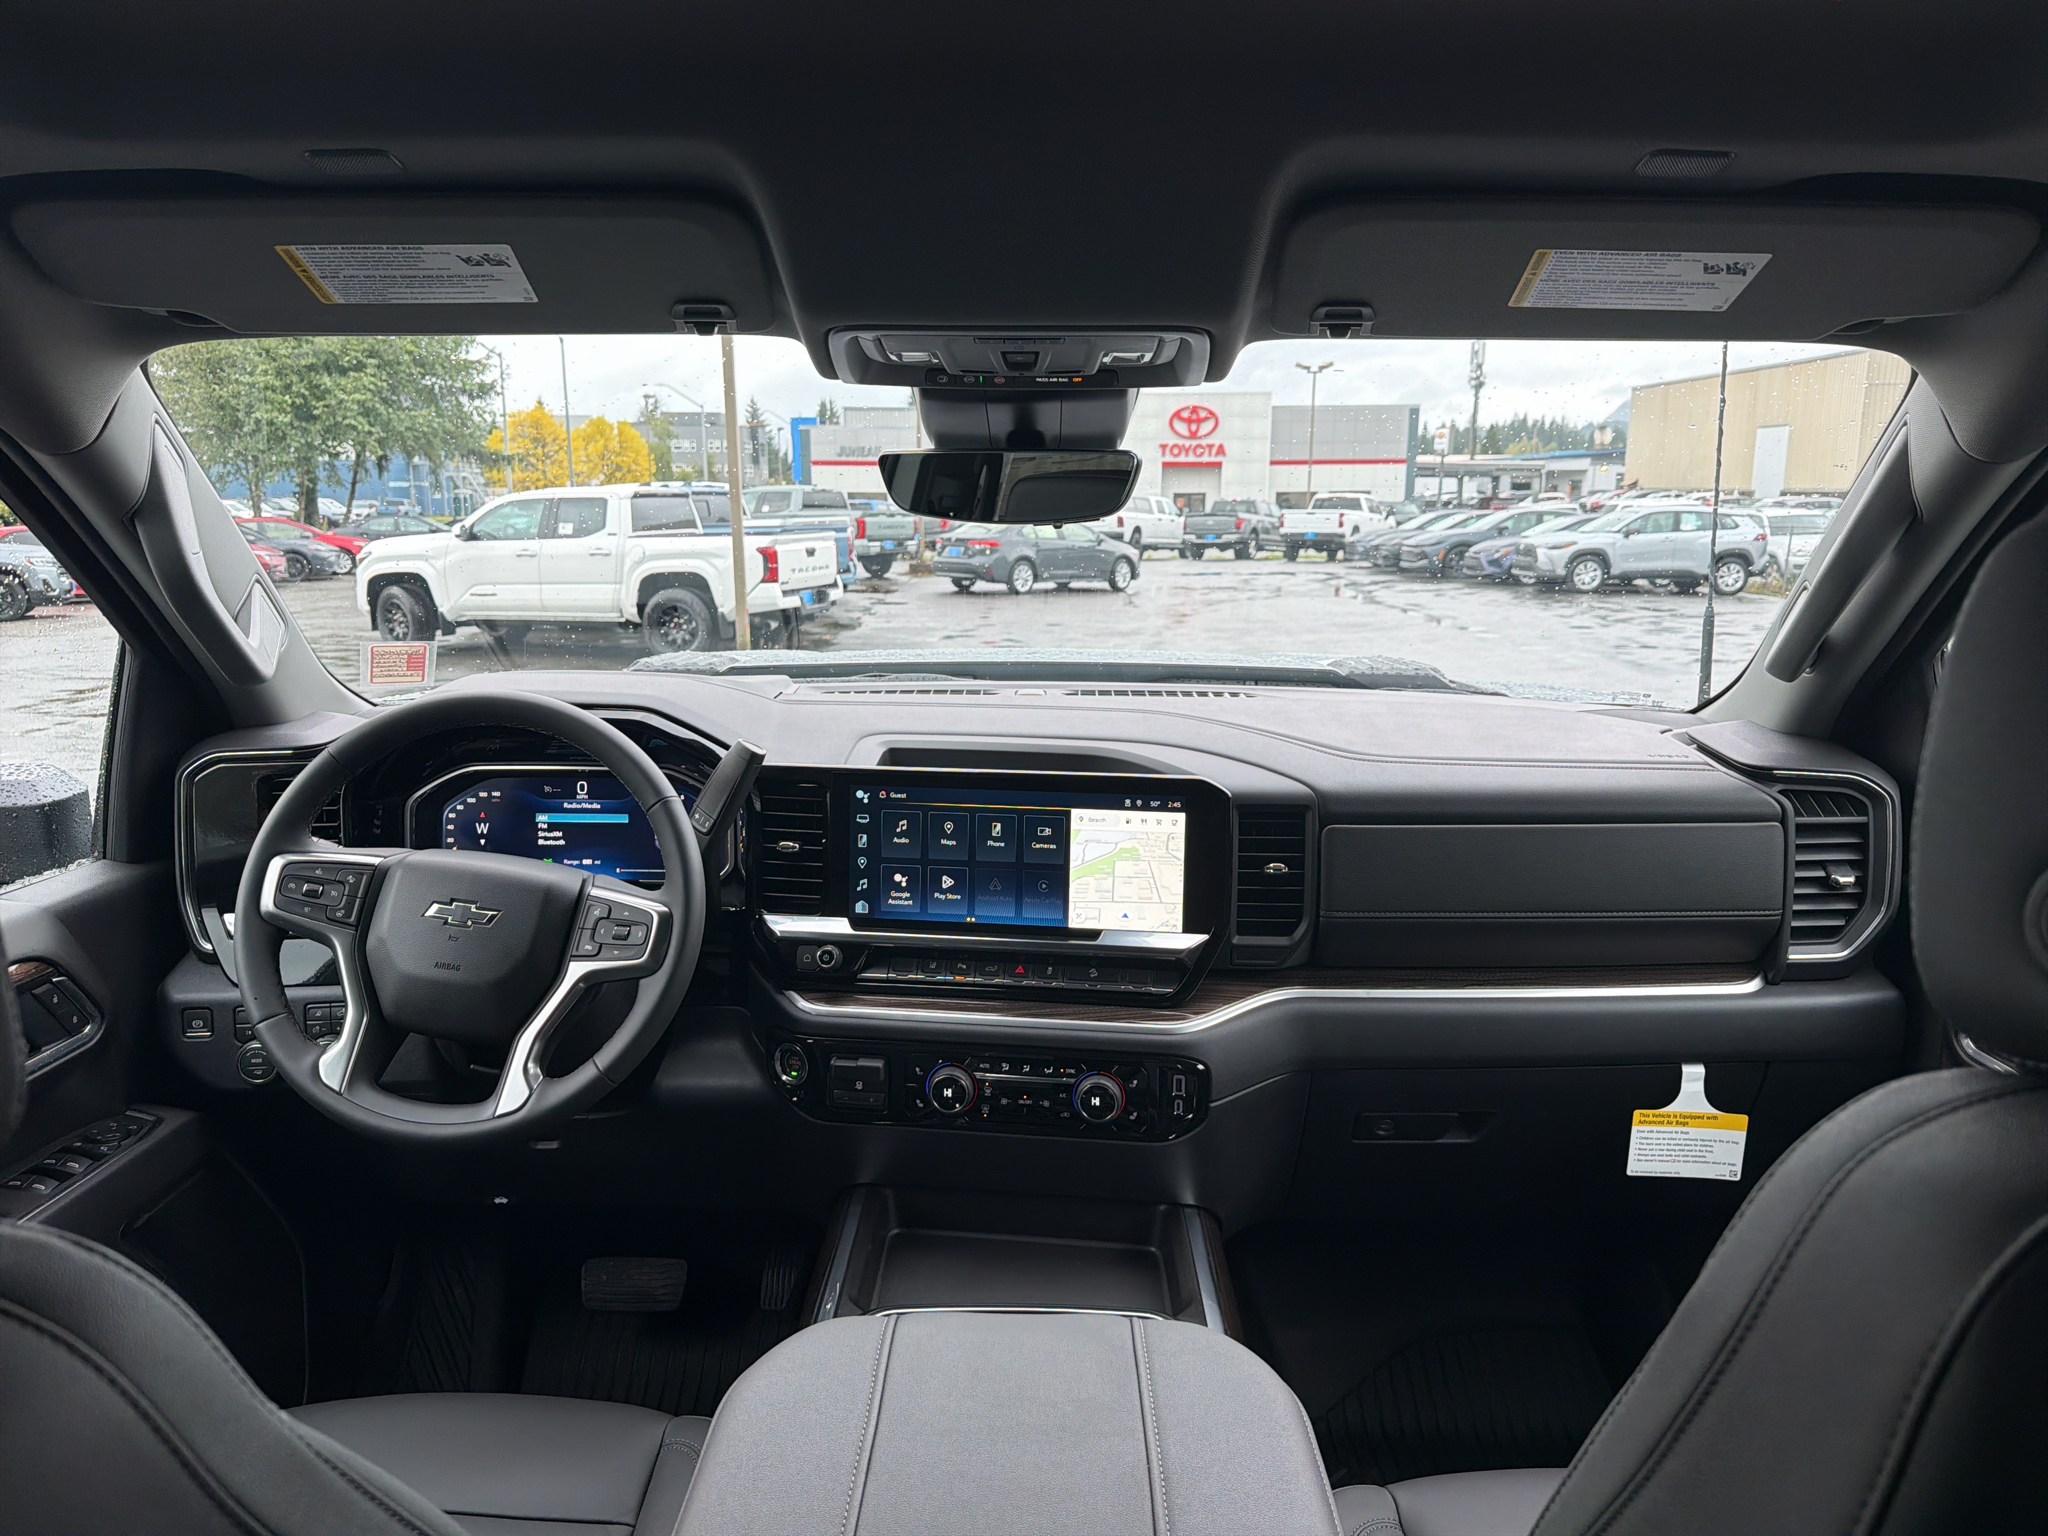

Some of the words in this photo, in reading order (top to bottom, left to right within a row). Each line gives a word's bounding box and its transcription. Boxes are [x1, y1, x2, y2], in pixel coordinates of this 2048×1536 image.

[1159, 443, 1226, 458] TOYOTA
[790, 564, 830, 574] TACOMA
[577, 781, 588, 794] 0
[476, 822, 489, 834] W
[434, 961, 461, 972] AIRBAG
[943, 1088, 952, 1097] HI
[1091, 1097, 1100, 1106] HI
